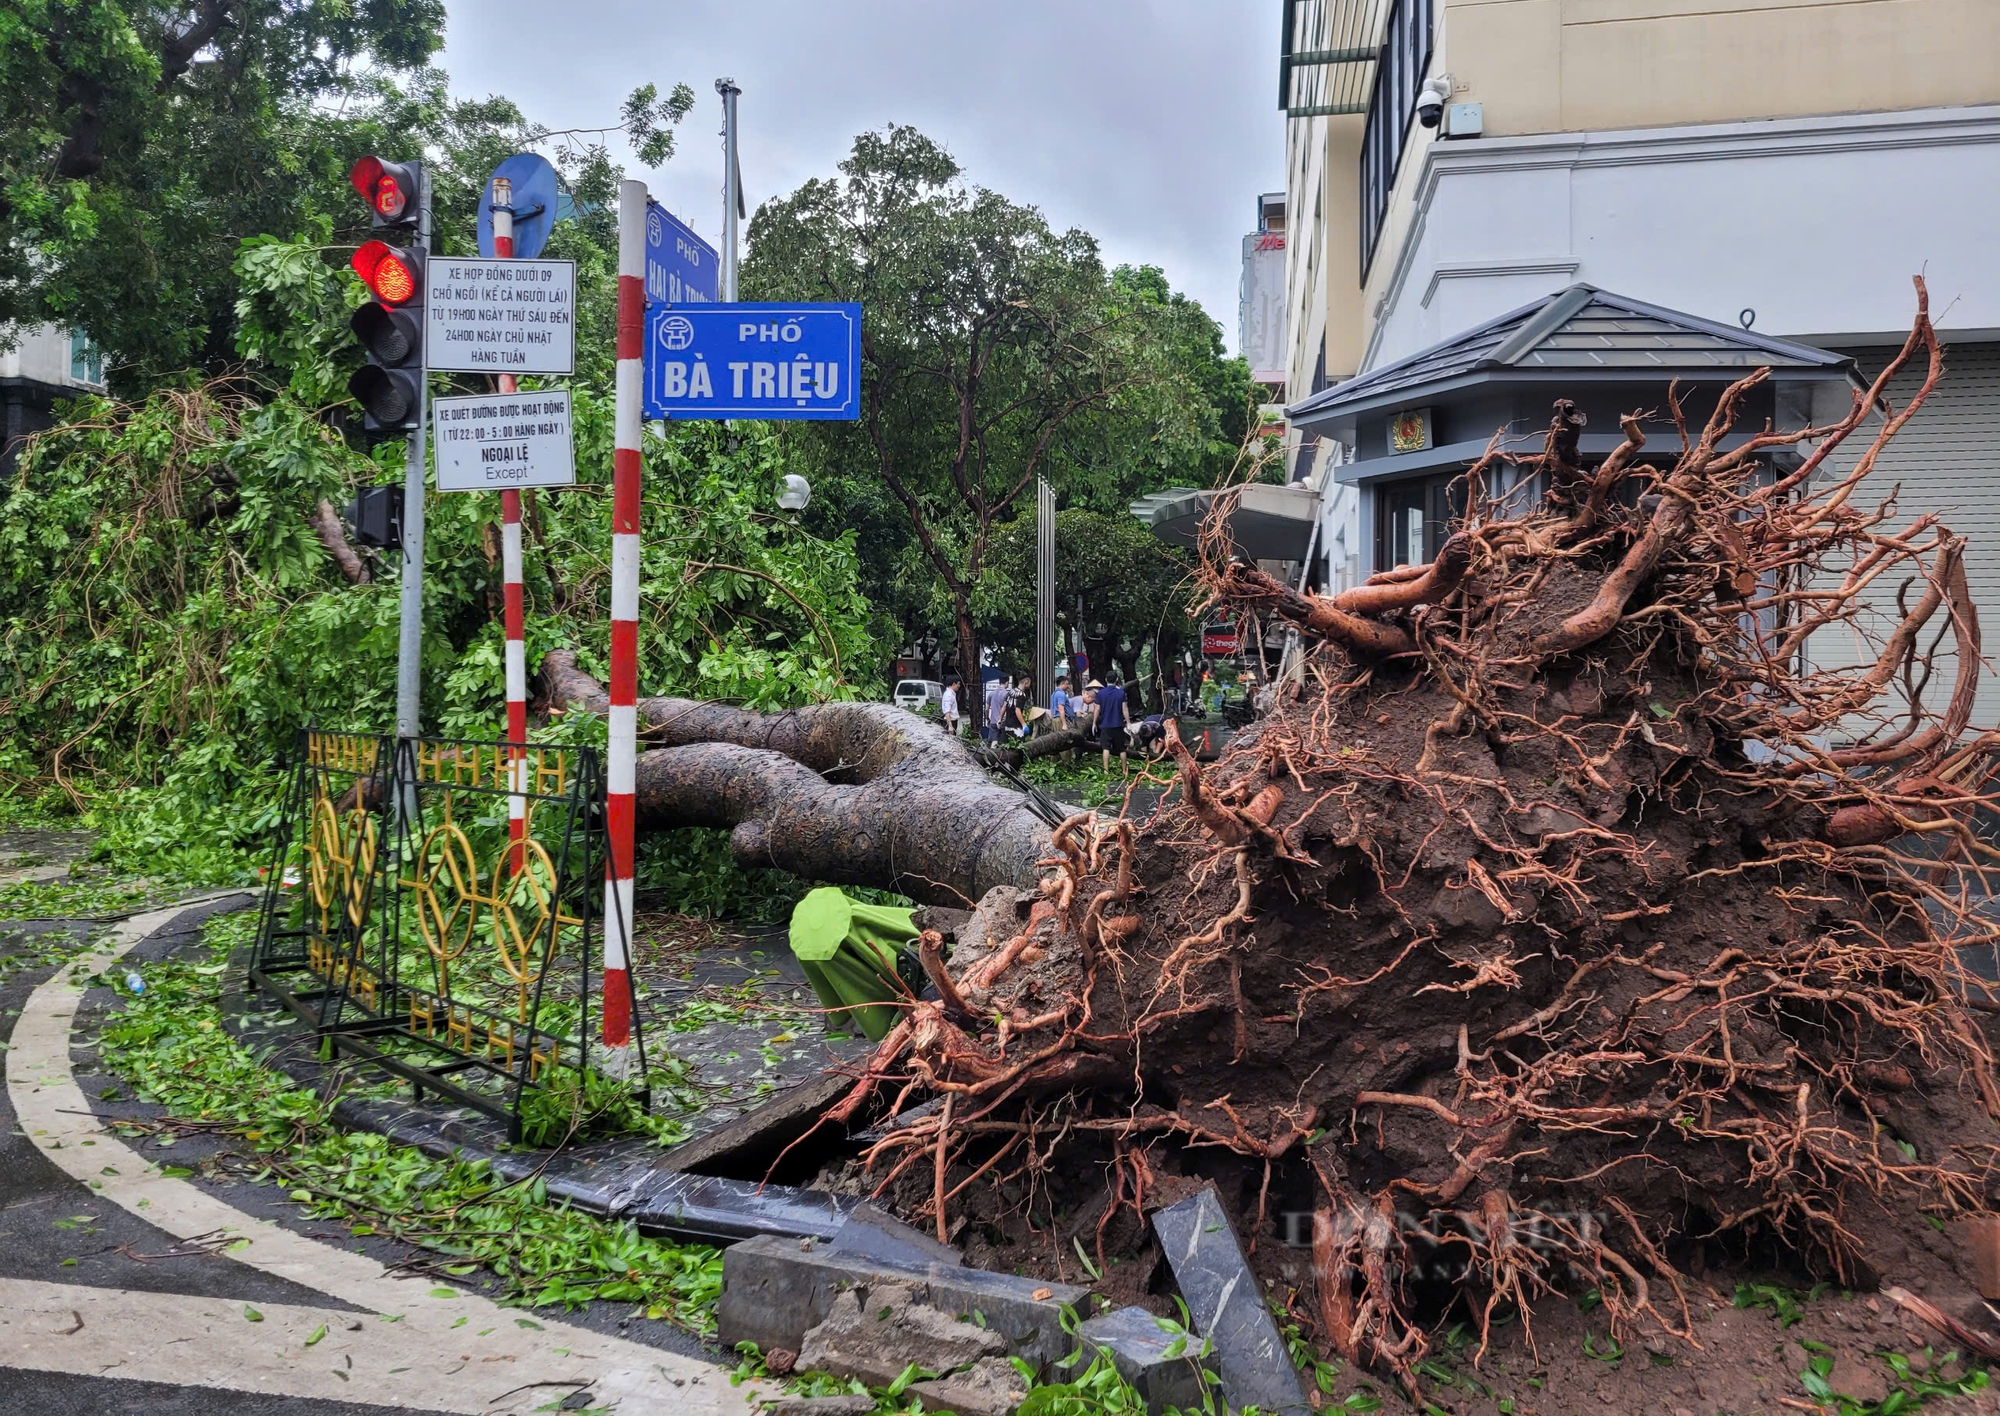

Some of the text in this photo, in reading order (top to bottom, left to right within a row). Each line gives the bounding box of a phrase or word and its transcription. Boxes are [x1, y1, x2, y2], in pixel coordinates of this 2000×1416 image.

[676, 237, 700, 267] PHỐ
[449, 264, 552, 283] XE HỢP ĐỒNG DƯỚI 09
[649, 258, 666, 303] HAI
[669, 269, 682, 303] BÀ
[432, 283, 452, 300] CHỖ
[481, 284, 500, 302] (KỂ
[501, 286, 513, 302] CẢ
[515, 286, 546, 303] NGƯỜI
[549, 287, 568, 303] LÁI)
[431, 304, 569, 324] TỪ 19H00 NGÀY THỨ SÁU ĐẾN
[445, 327, 553, 347] 24H00 NGÀY CHỦ NHẬT
[739, 316, 806, 342] PHỐ
[471, 347, 526, 364] HÀNG TUẦN
[663, 352, 839, 407] BÀ TRIỆU
[439, 399, 565, 421] XE QUÉT ĐƯỜNG ĐƯỢC HOẠT ĐỘNG
[514, 421, 536, 437] HÀNG
[481, 443, 529, 464] NGOẠI LỆ
[486, 465, 528, 482] Except
